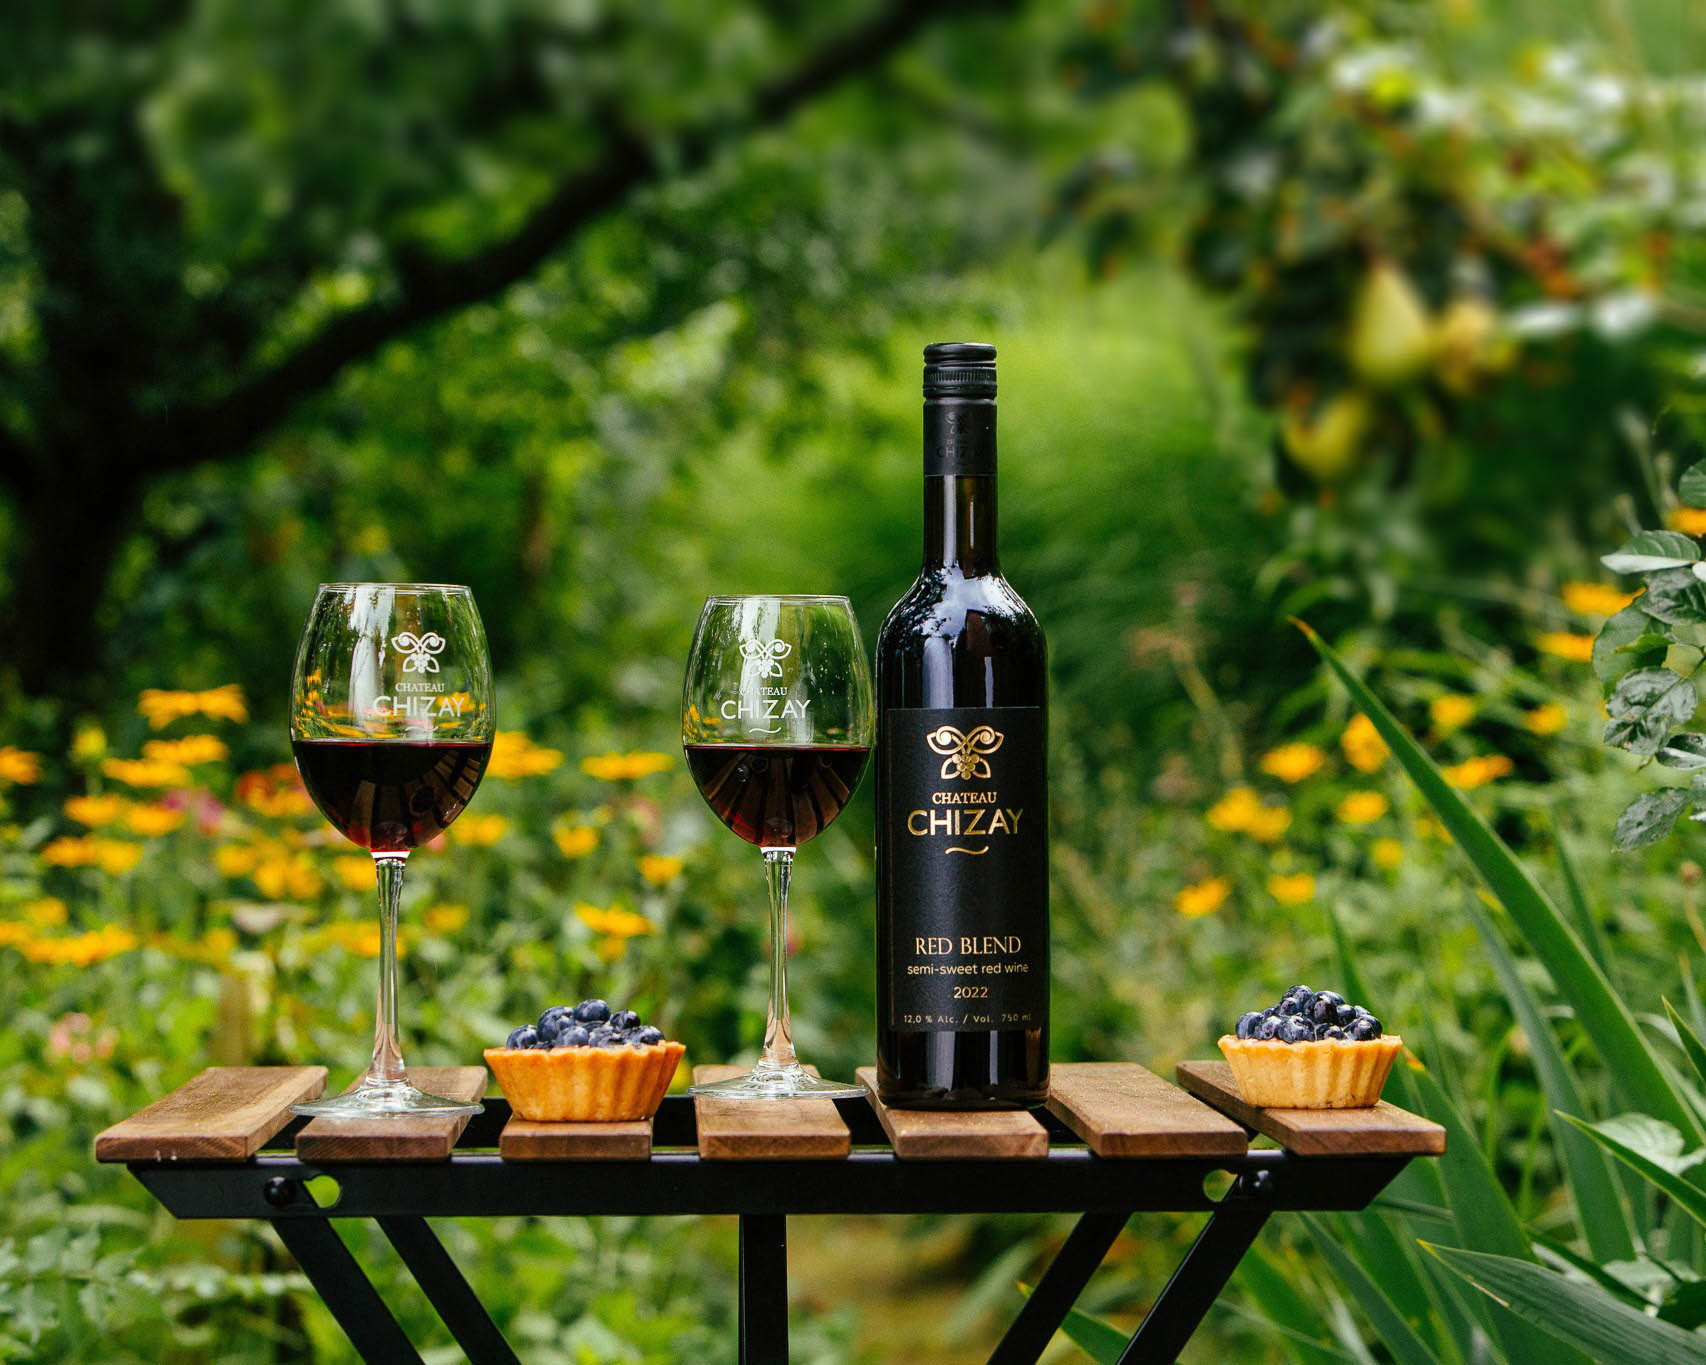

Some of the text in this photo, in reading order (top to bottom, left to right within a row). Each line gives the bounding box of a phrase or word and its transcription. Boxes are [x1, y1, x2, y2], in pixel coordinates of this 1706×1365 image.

[395, 682, 445, 693] CHATEAU
[373, 695, 465, 718] CHIZAY
[721, 699, 811, 720] CHIZAY
[932, 791, 998, 805] CHATEAU
[907, 808, 1024, 836] CHIZAY
[915, 936, 1021, 955] RED BLEND
[907, 962, 1029, 975] semi-sweet red wine
[953, 986, 989, 999] 2022
[925, 1015, 933, 1023] %
[937, 1015, 959, 1024] Alc.
[962, 1014, 969, 1024] /
[1001, 1013, 1019, 1023] 750
[1022, 1014, 1032, 1022] ml
